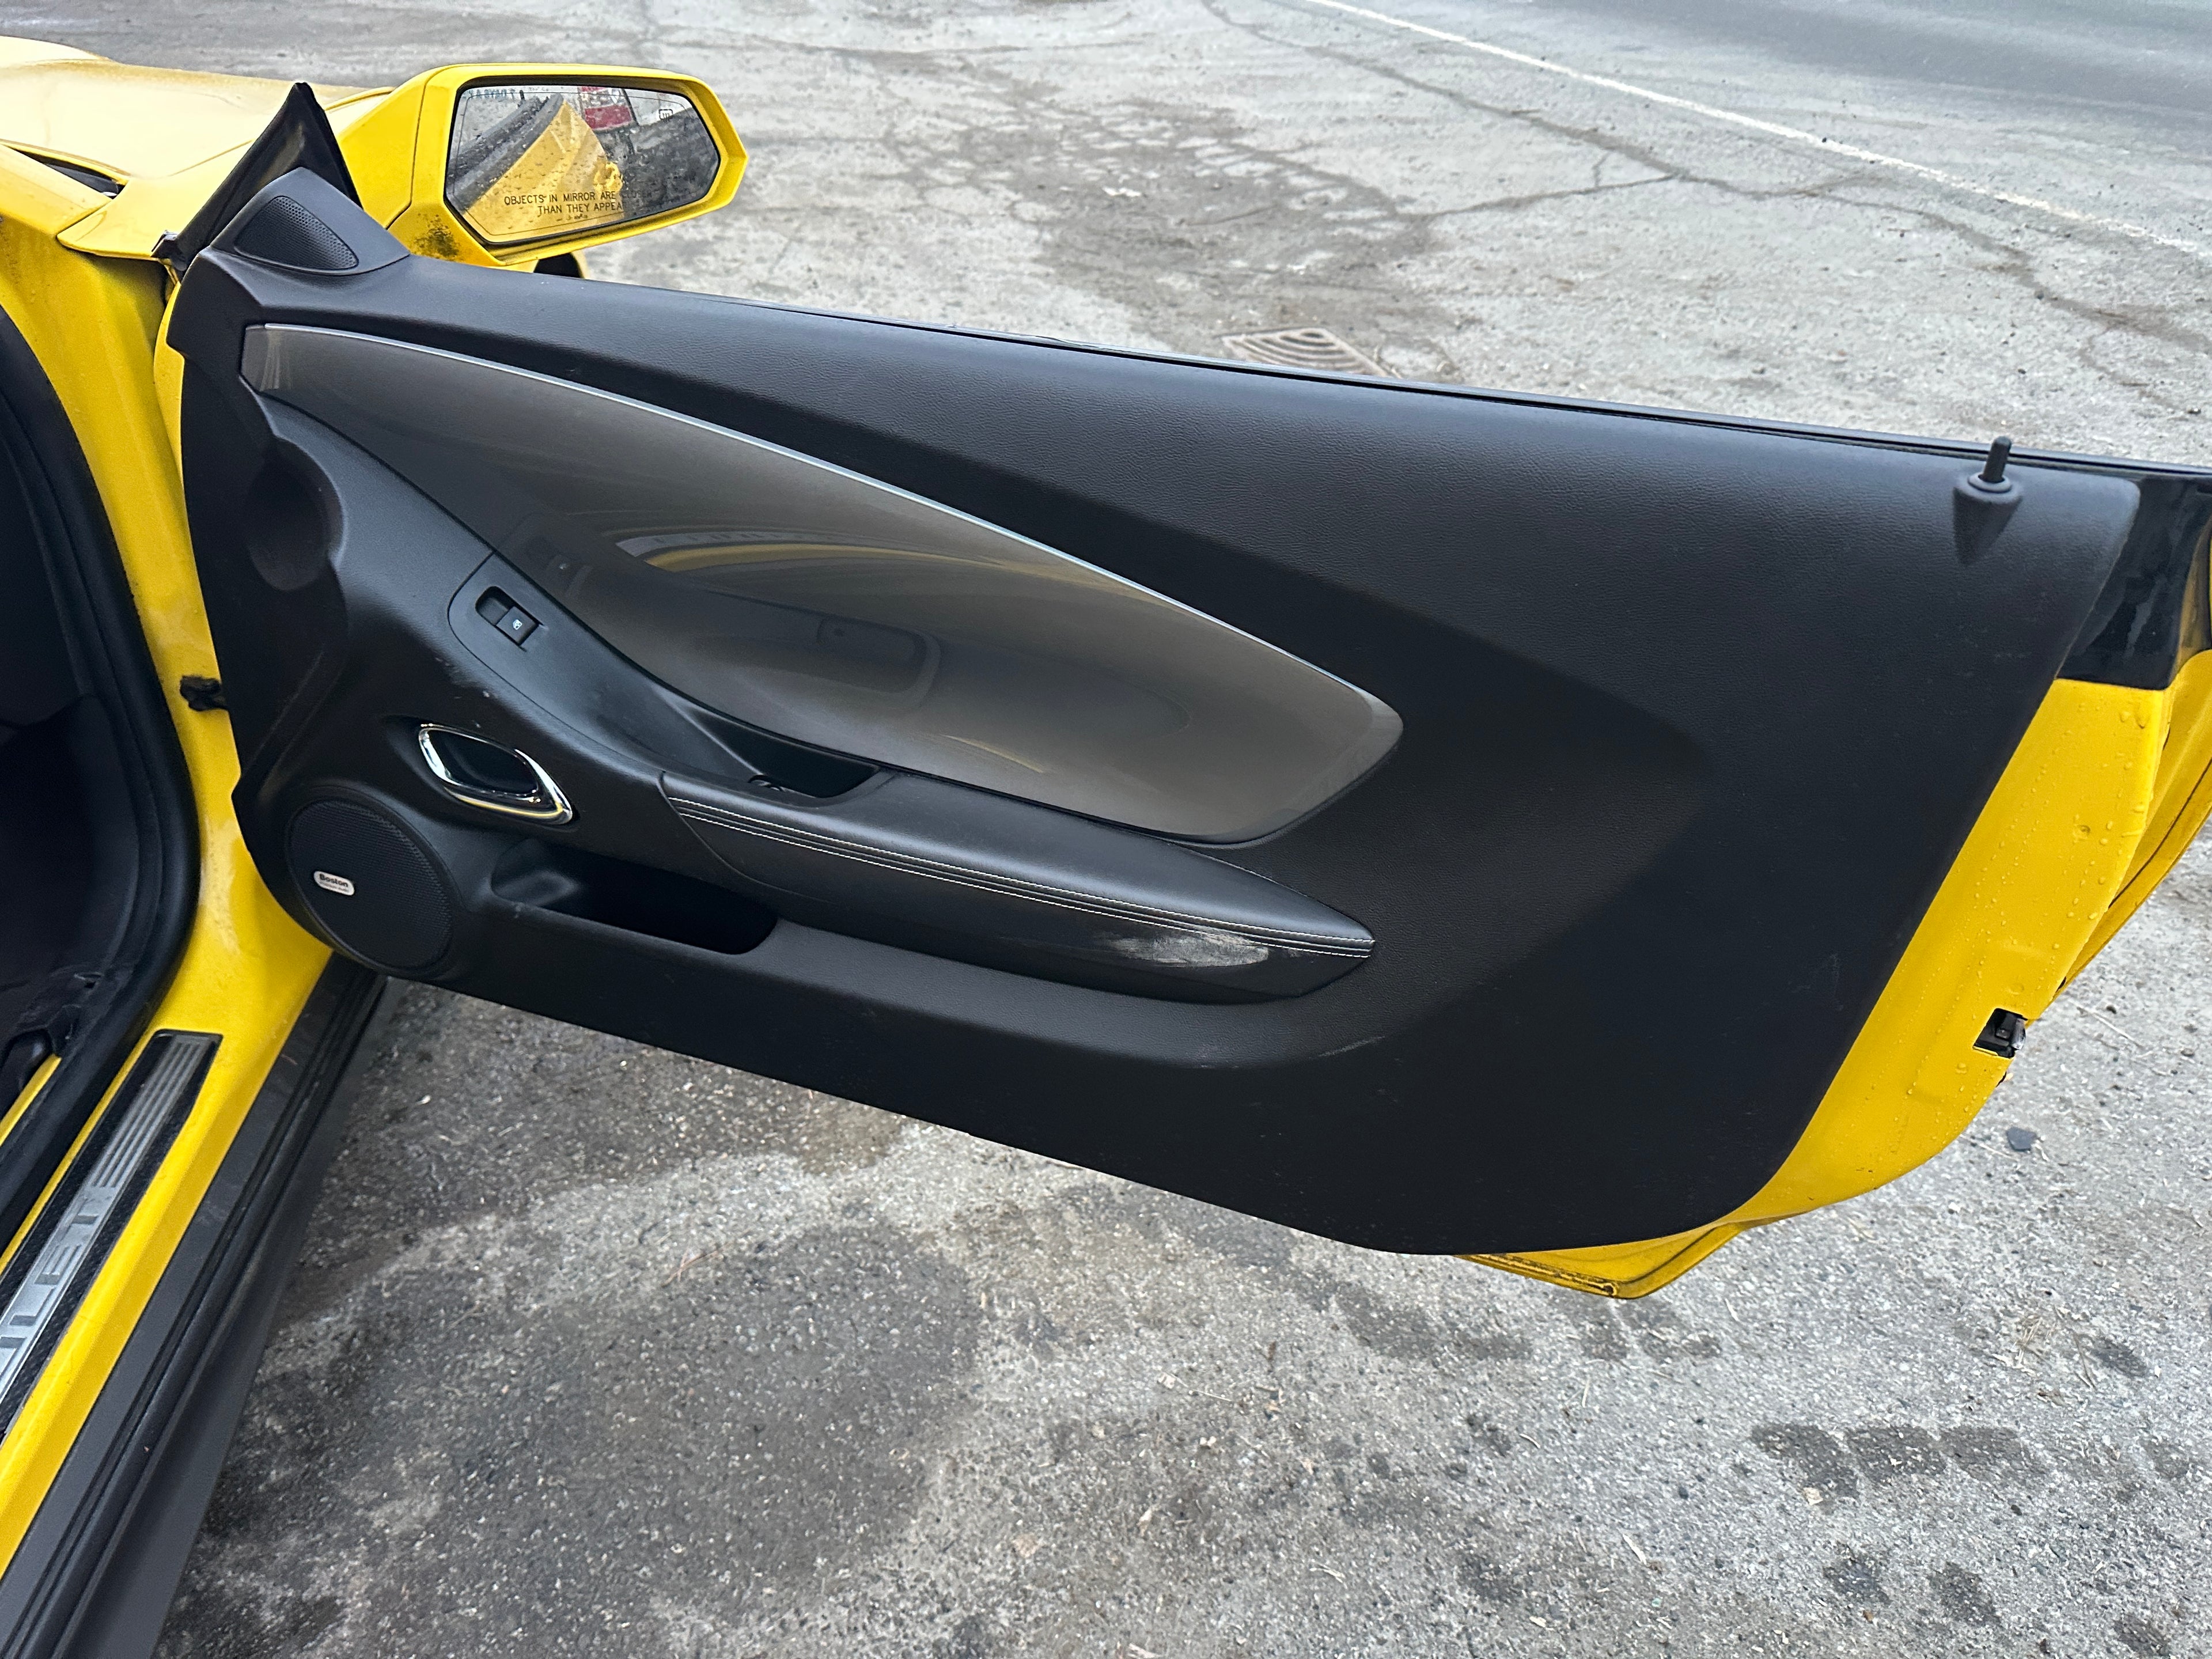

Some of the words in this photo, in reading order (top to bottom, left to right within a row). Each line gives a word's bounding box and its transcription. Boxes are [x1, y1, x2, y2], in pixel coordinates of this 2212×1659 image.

[504, 195, 544, 205] OBJECTS
[550, 194, 558, 202] IN
[563, 192, 596, 202] MIRROR
[600, 191, 616, 199] ARE
[537, 205, 562, 215] THAN
[566, 203, 589, 213] THEY
[319, 873, 349, 887] Boston
